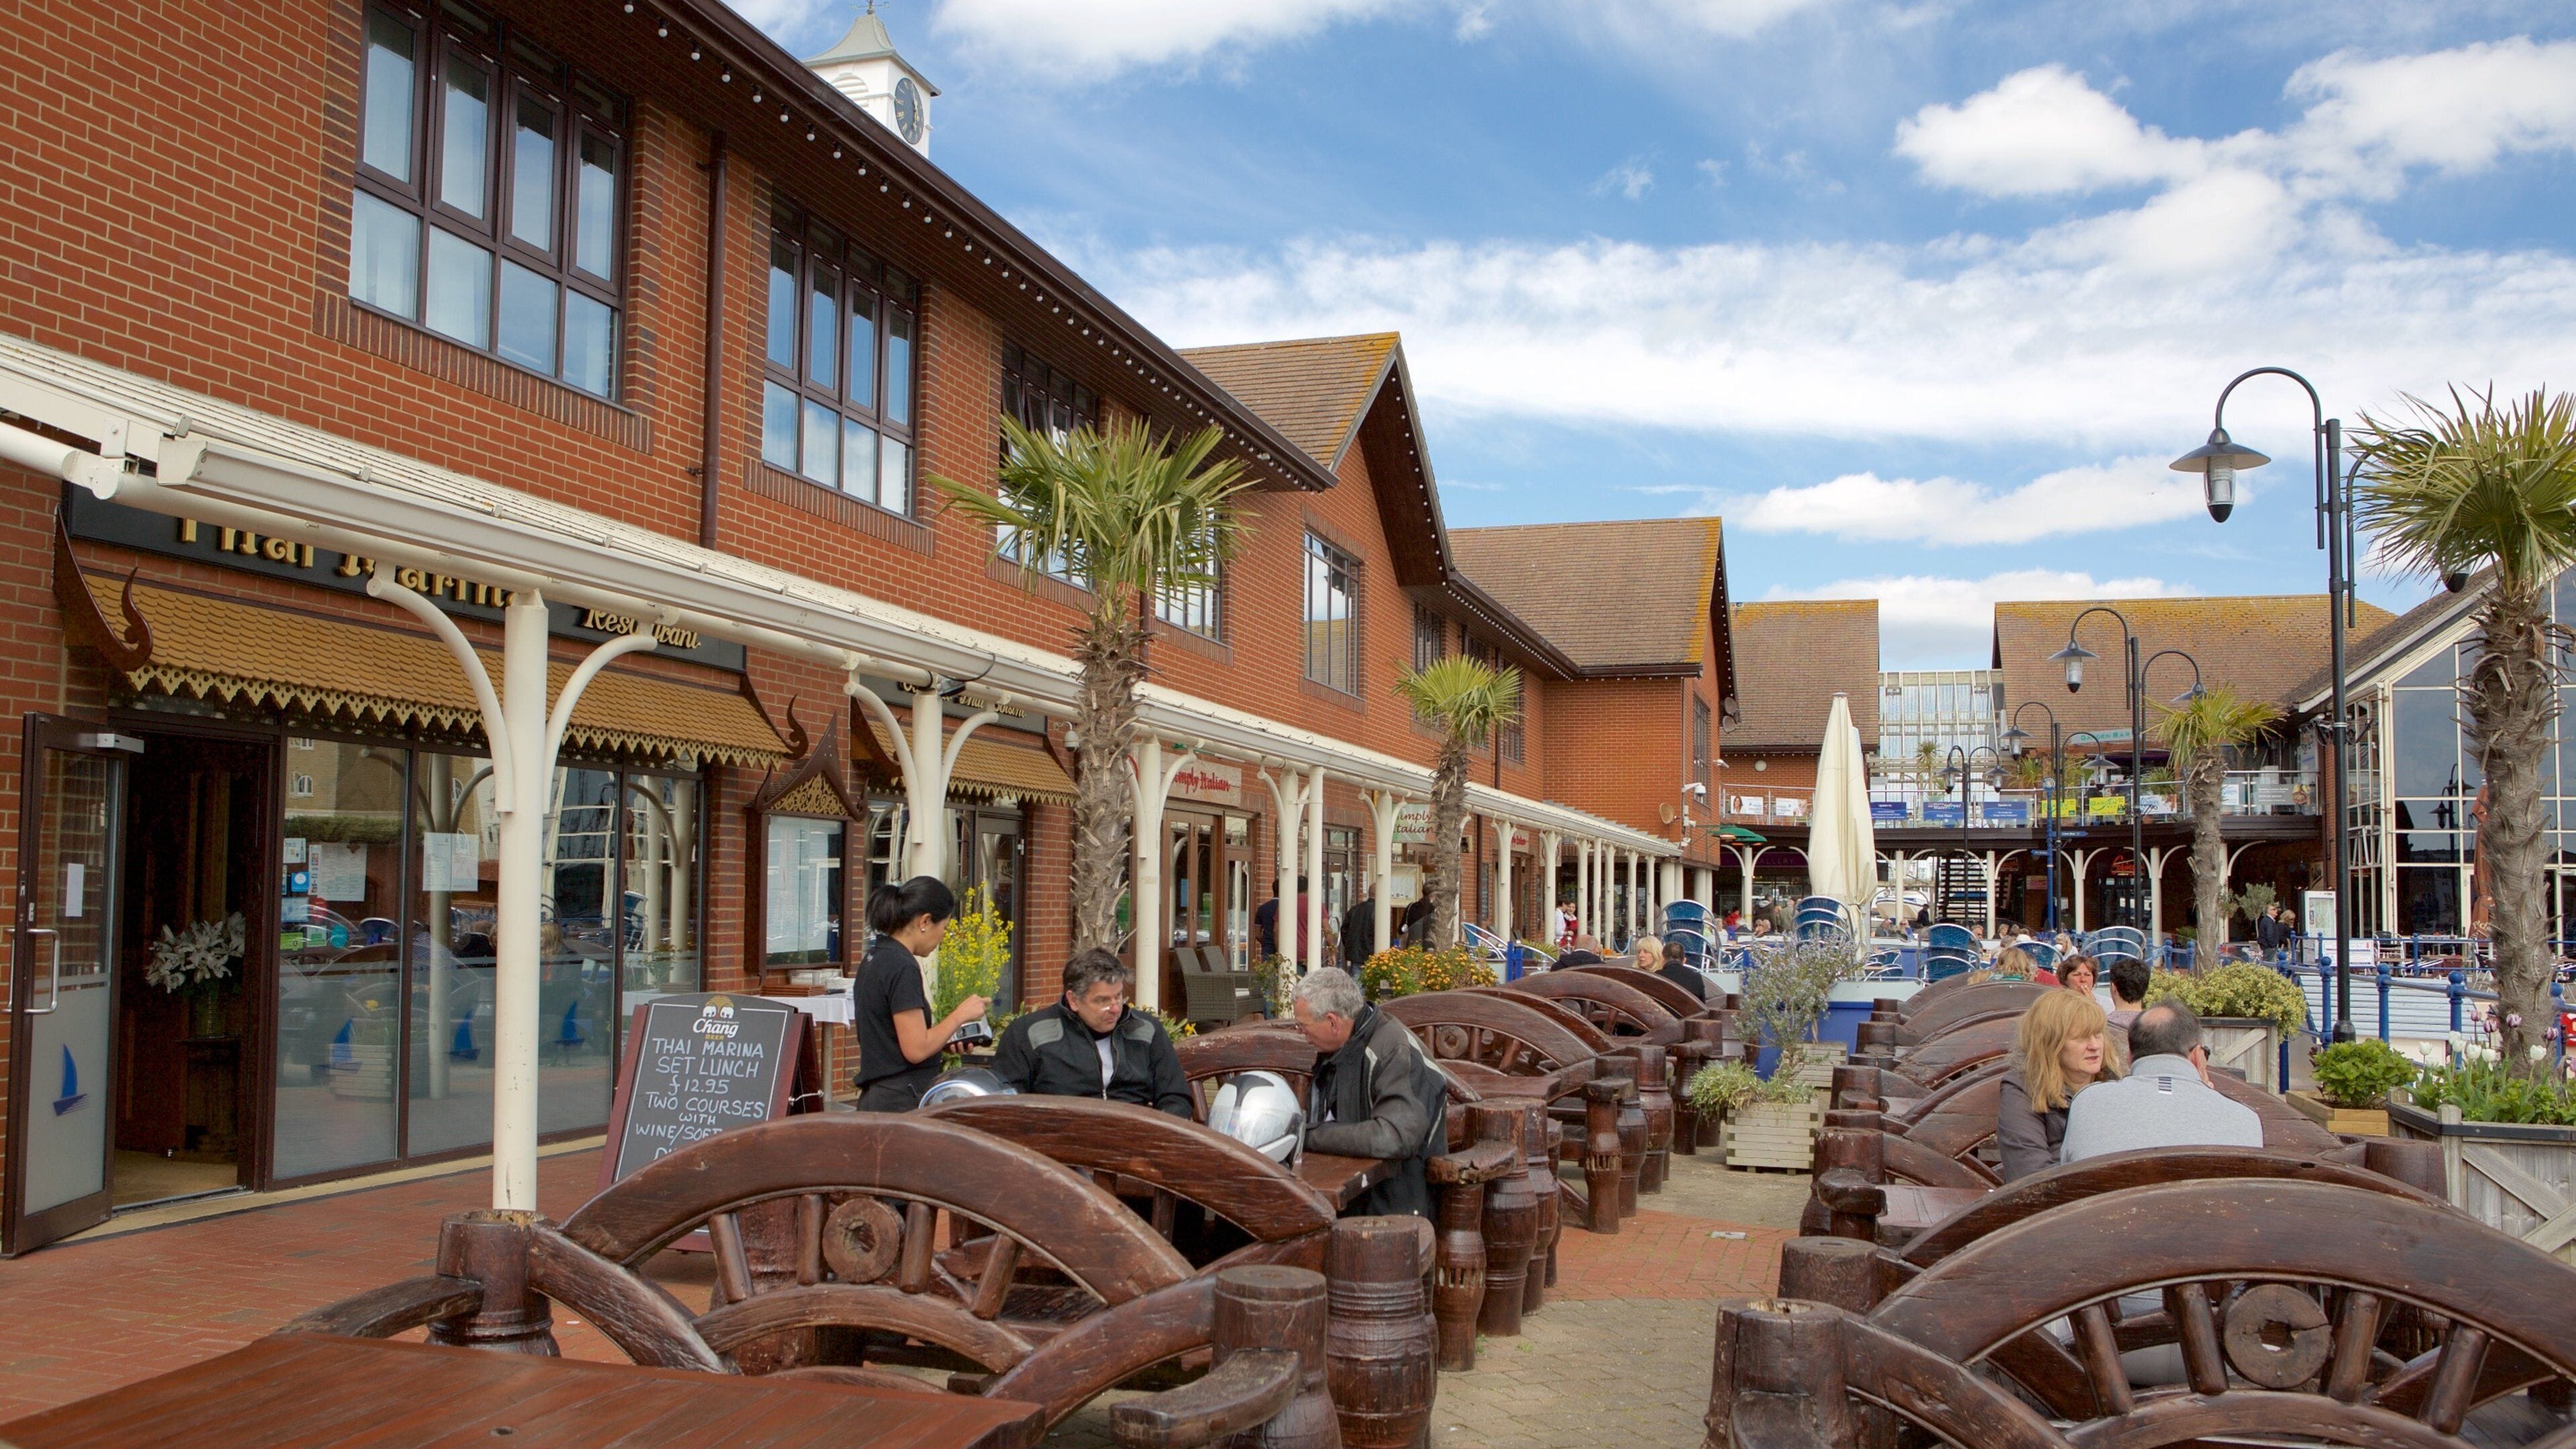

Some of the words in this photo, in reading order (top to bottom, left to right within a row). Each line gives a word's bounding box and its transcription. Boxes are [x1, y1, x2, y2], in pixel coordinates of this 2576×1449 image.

[692, 1018, 739, 1038] Chang
[652, 1038, 692, 1055] THAI
[702, 1040, 765, 1059] MARINA
[655, 1056, 696, 1075] SET
[699, 1057, 759, 1078] LUNCH
[645, 1091, 678, 1110] TWO
[685, 1097, 765, 1118] COURSES
[679, 1112, 716, 1126] WITH
